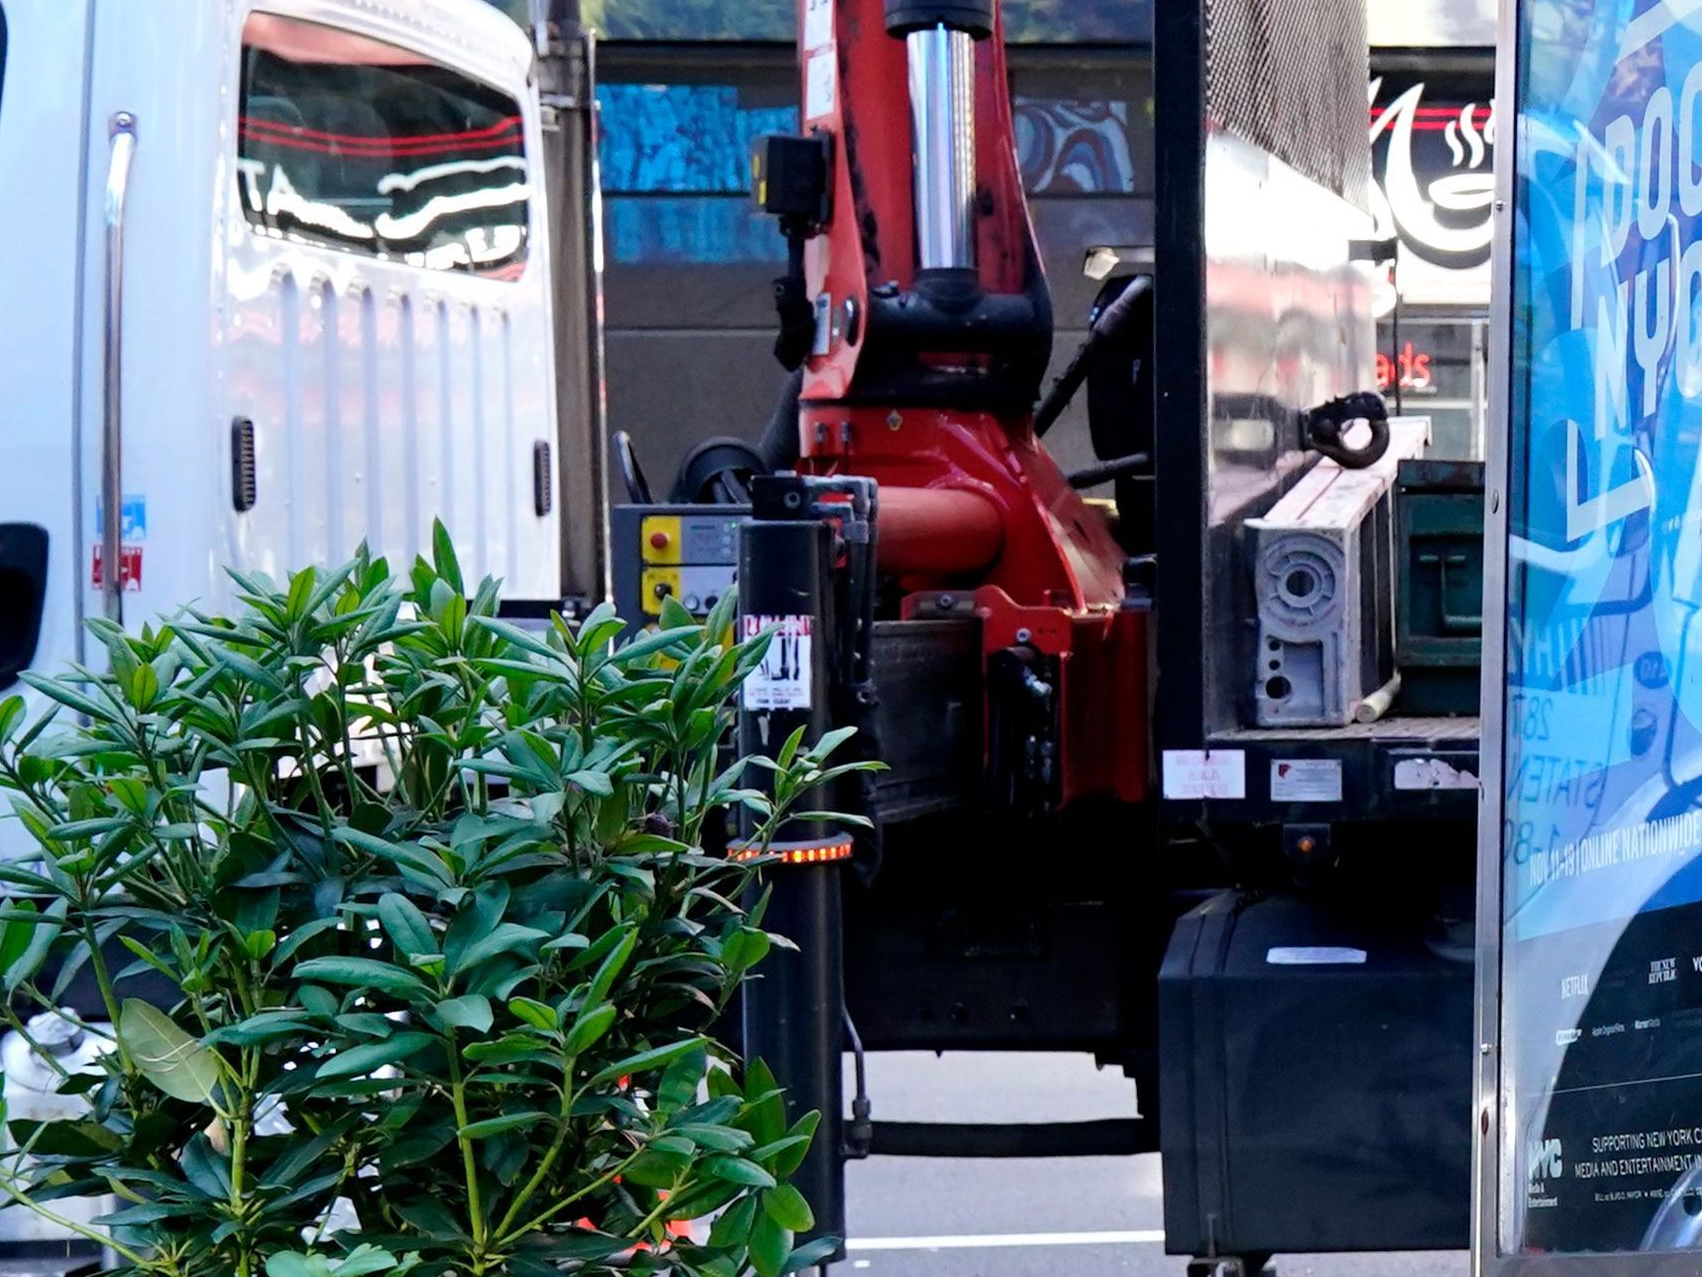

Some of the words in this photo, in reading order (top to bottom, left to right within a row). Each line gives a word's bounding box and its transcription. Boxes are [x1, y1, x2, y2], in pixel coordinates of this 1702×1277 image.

[1530, 852, 1548, 886] NOV
[1580, 830, 1620, 872] ONLINE
[1622, 810, 1701, 861] NATIONWIDE
[1561, 973, 1589, 1000] NETFLIX
[1592, 1132, 1645, 1153] SUPPORTING
[1646, 1131, 1665, 1149] NEW
[1667, 1127, 1692, 1147] YORK
[1528, 1138, 1562, 1179] NYC
[1575, 1161, 1599, 1179] MEDIA
[1601, 1160, 1619, 1177] AND
[1620, 1153, 1692, 1176] ENTERTAINMENT
